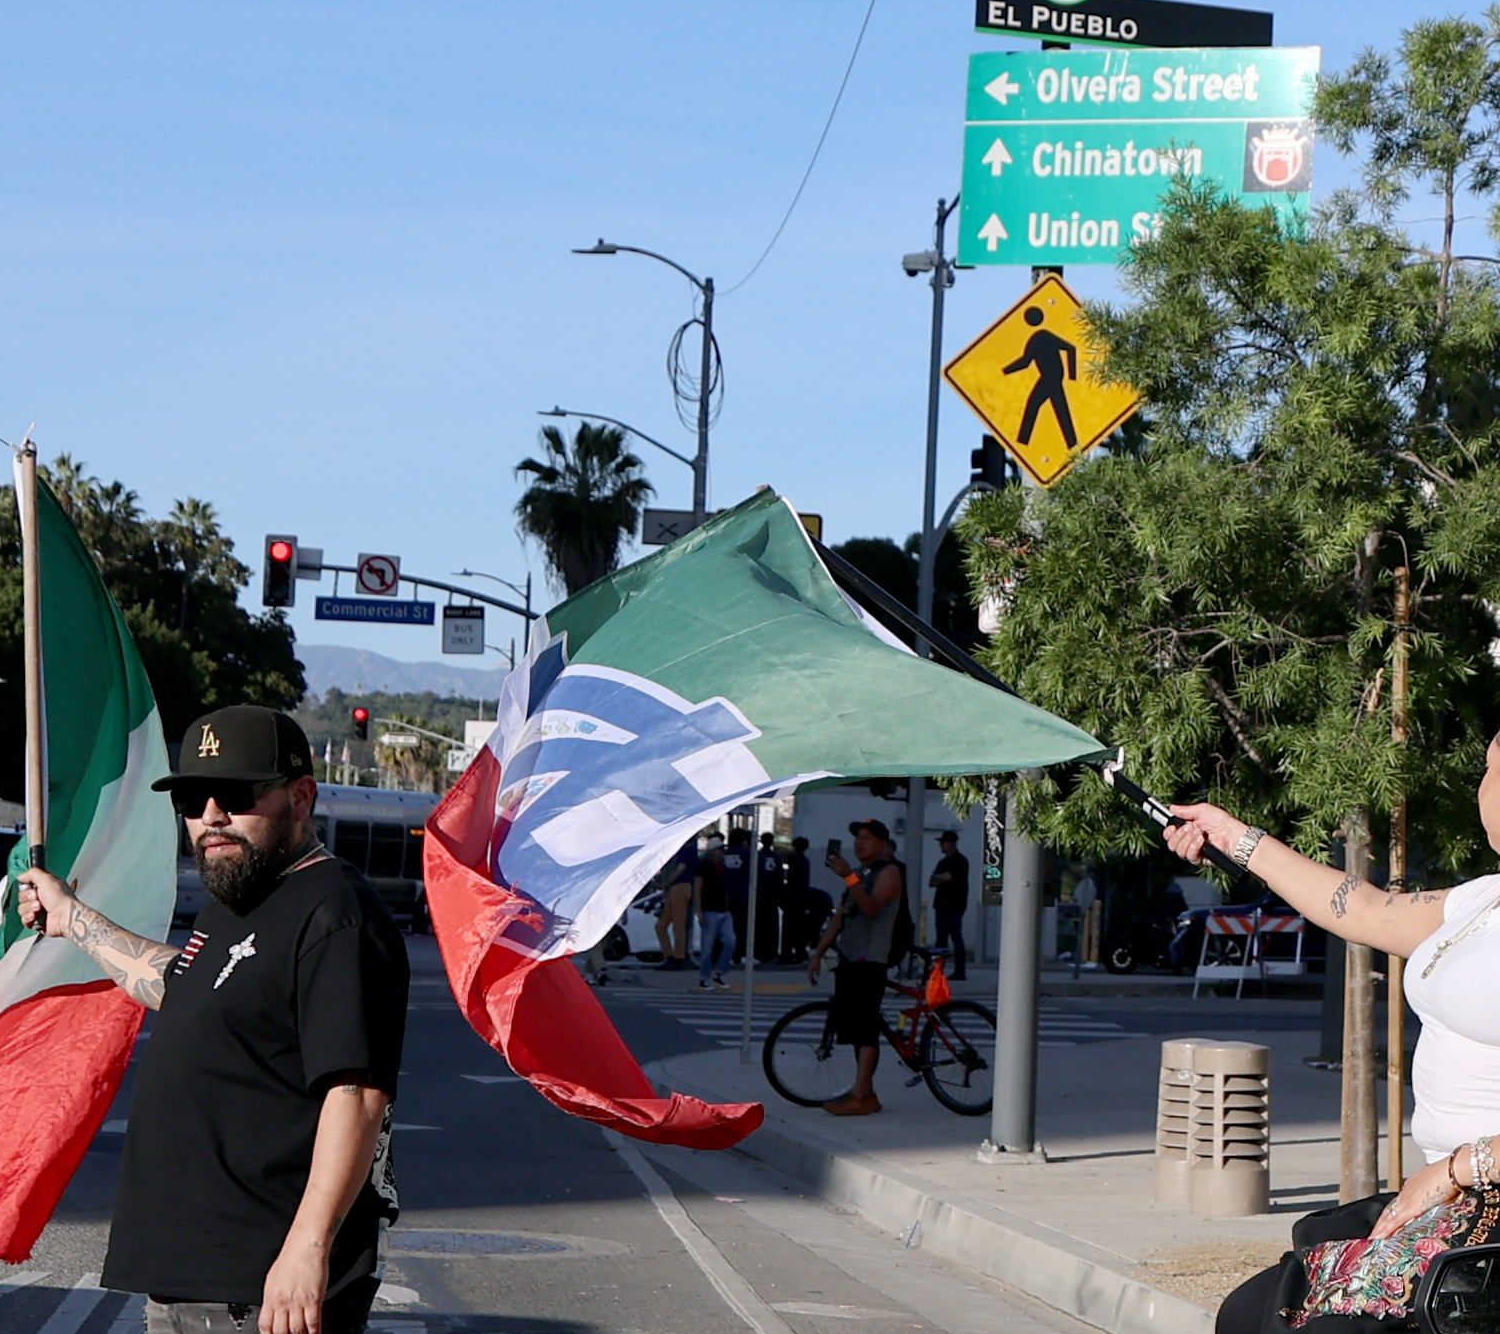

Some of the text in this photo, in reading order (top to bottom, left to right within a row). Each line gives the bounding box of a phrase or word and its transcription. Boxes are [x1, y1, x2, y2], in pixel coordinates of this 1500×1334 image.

[987, 0, 1139, 41] EL PUEBLO
[1035, 65, 1260, 104] Olvera Street
[1032, 140, 1202, 178] Chinatown
[1027, 210, 1119, 248] Union
[322, 601, 429, 620] Commercial St
[454, 624, 473, 633] BUS
[451, 635, 474, 645] ONLY
[198, 723, 220, 758] LA
